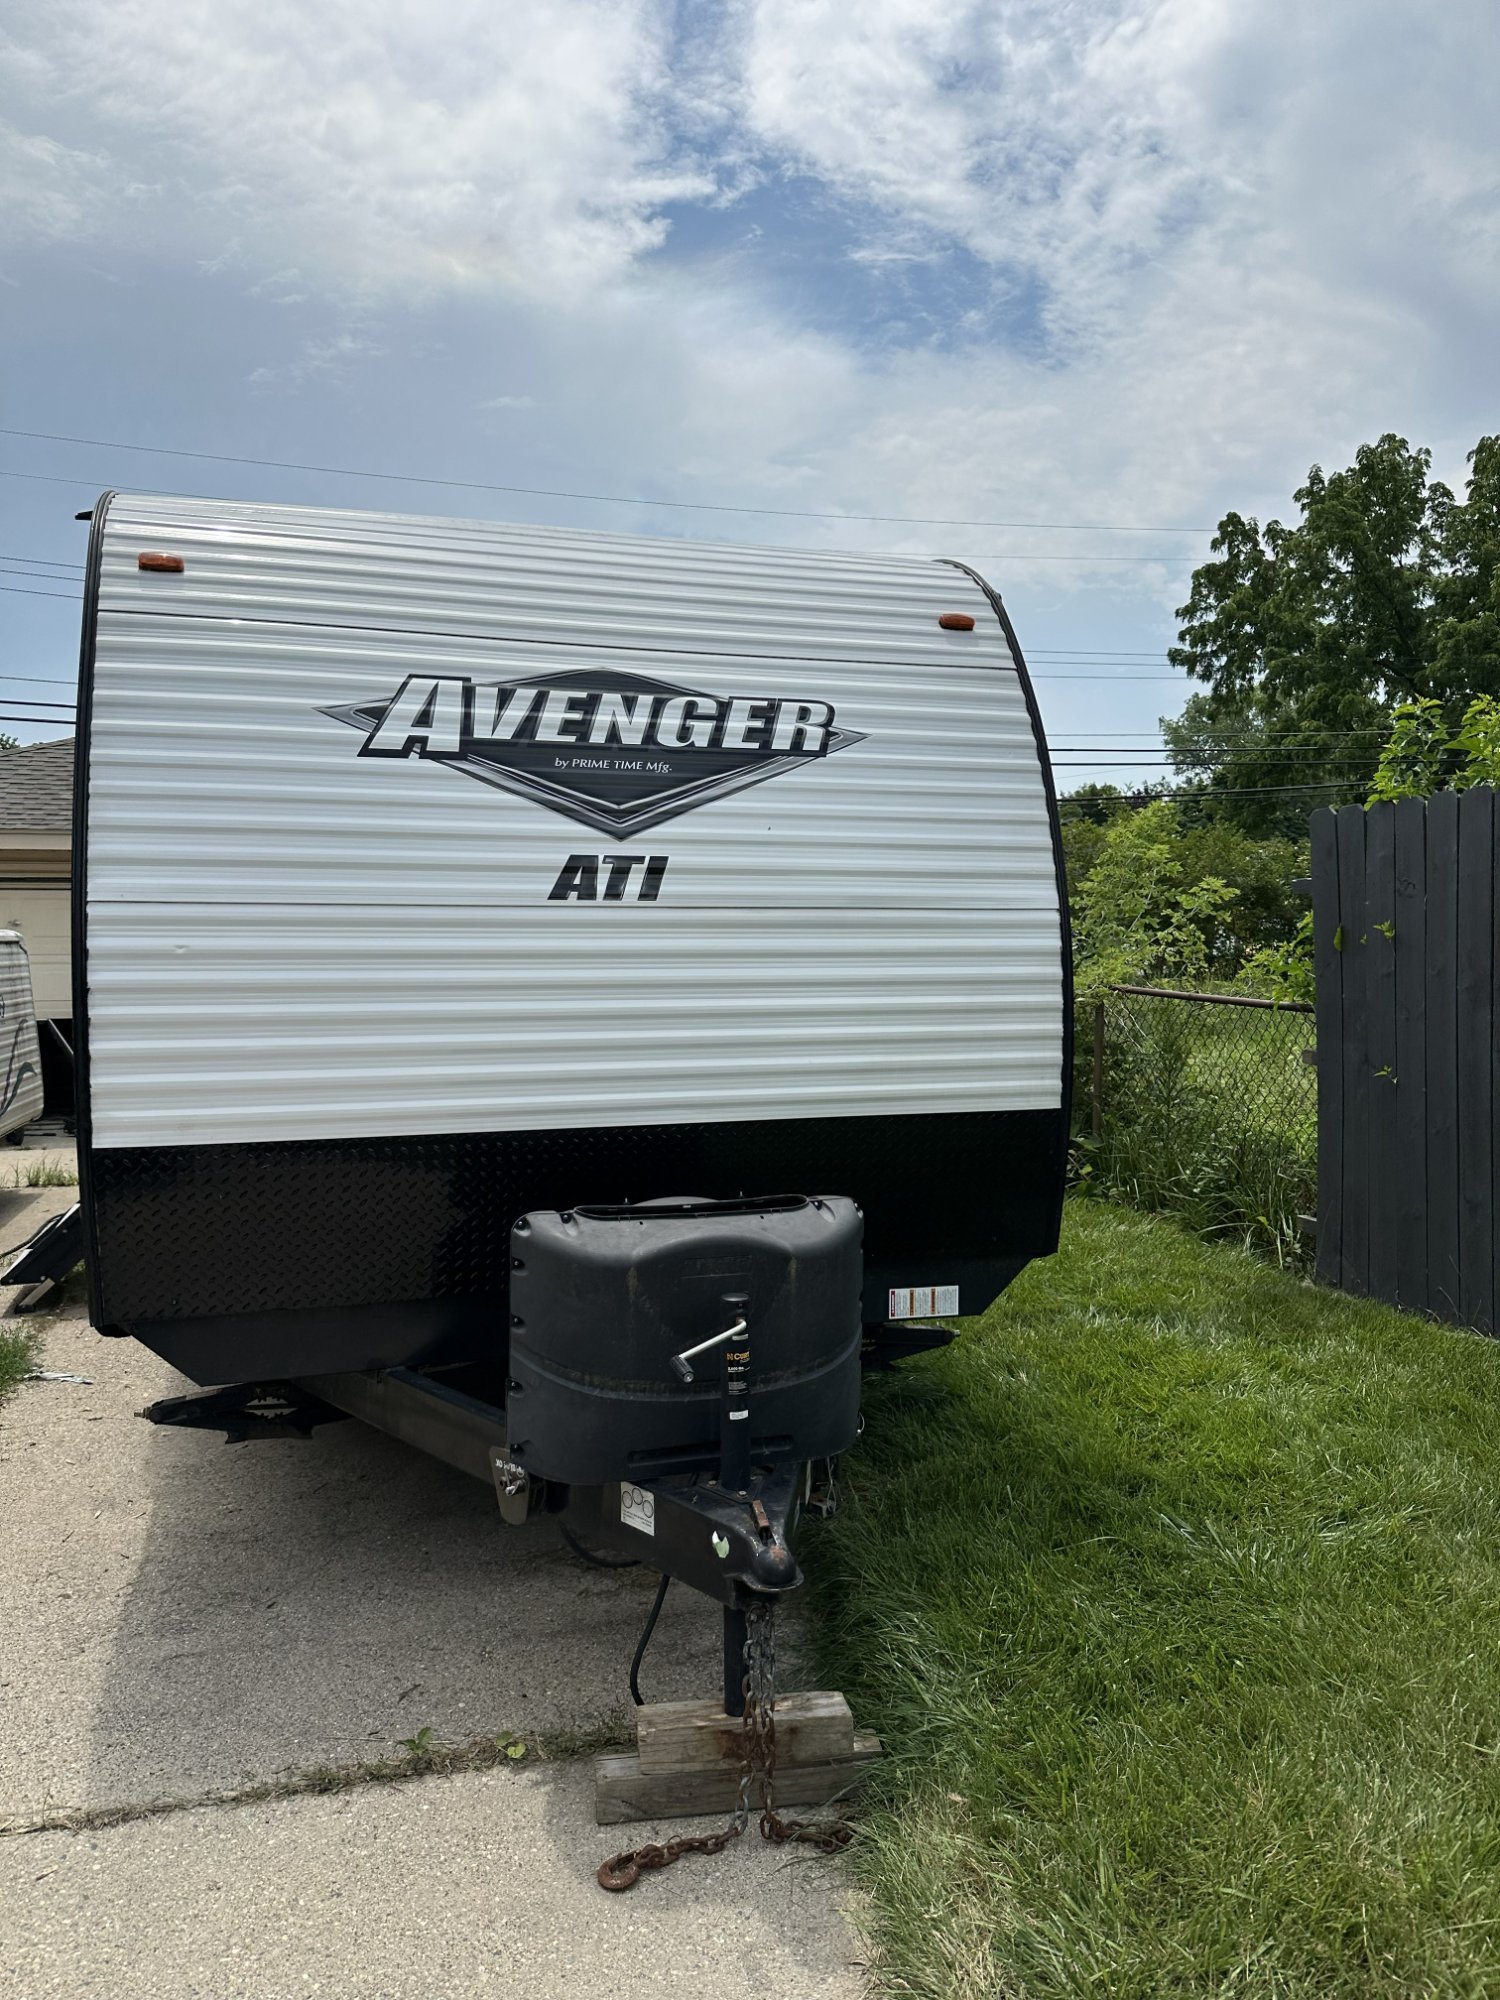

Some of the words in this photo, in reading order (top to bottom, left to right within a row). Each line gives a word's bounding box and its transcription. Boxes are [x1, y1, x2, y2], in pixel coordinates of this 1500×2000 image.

[357, 673, 835, 758] AVENGER
[555, 757, 569, 769] by
[572, 758, 610, 769] PRIME
[614, 760, 643, 770] TIME
[646, 762, 673, 773] Mfg.
[547, 854, 669, 901] ATI
